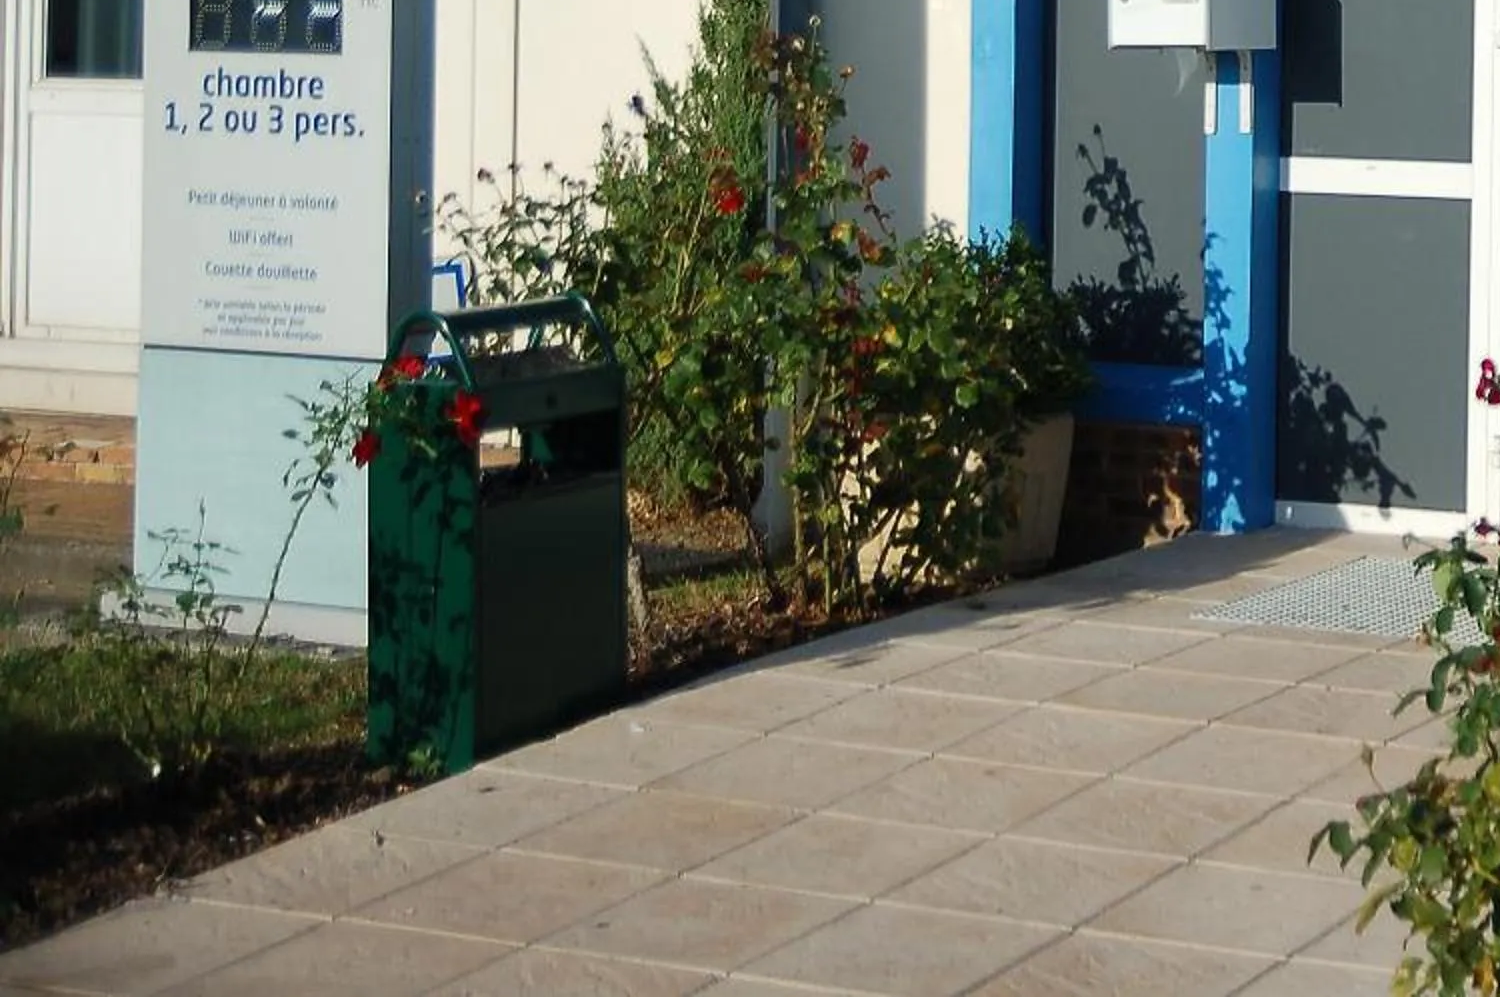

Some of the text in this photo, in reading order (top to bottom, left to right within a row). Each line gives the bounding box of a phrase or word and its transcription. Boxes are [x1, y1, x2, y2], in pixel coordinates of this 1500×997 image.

[203, 67, 324, 100] chambre
[165, 102, 365, 143] 1, 2 ou 3 pers.
[188, 190, 217, 204] Petit
[221, 191, 275, 210] déjeuner
[292, 194, 338, 210] volonté
[259, 230, 293, 247] offert
[205, 260, 252, 277] Couette
